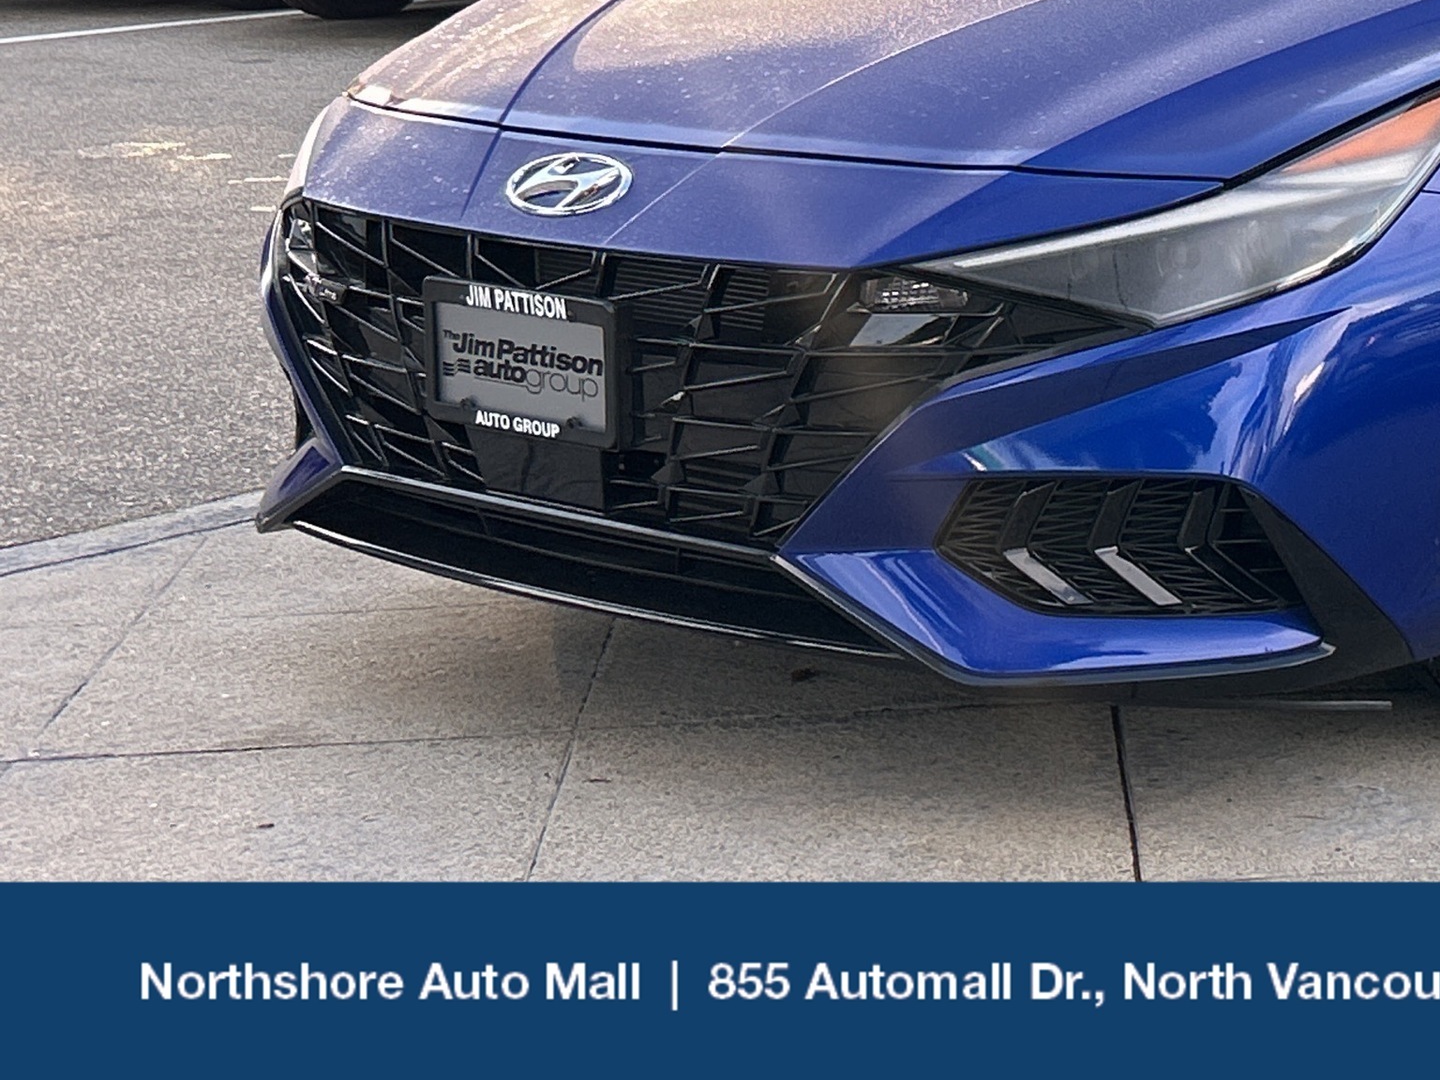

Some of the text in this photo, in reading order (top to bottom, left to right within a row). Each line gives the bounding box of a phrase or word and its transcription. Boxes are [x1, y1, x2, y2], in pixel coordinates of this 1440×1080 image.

[466, 285, 567, 320] JIM PATTISON
[443, 329, 460, 340] The
[475, 410, 560, 438] AUTO GROUP
